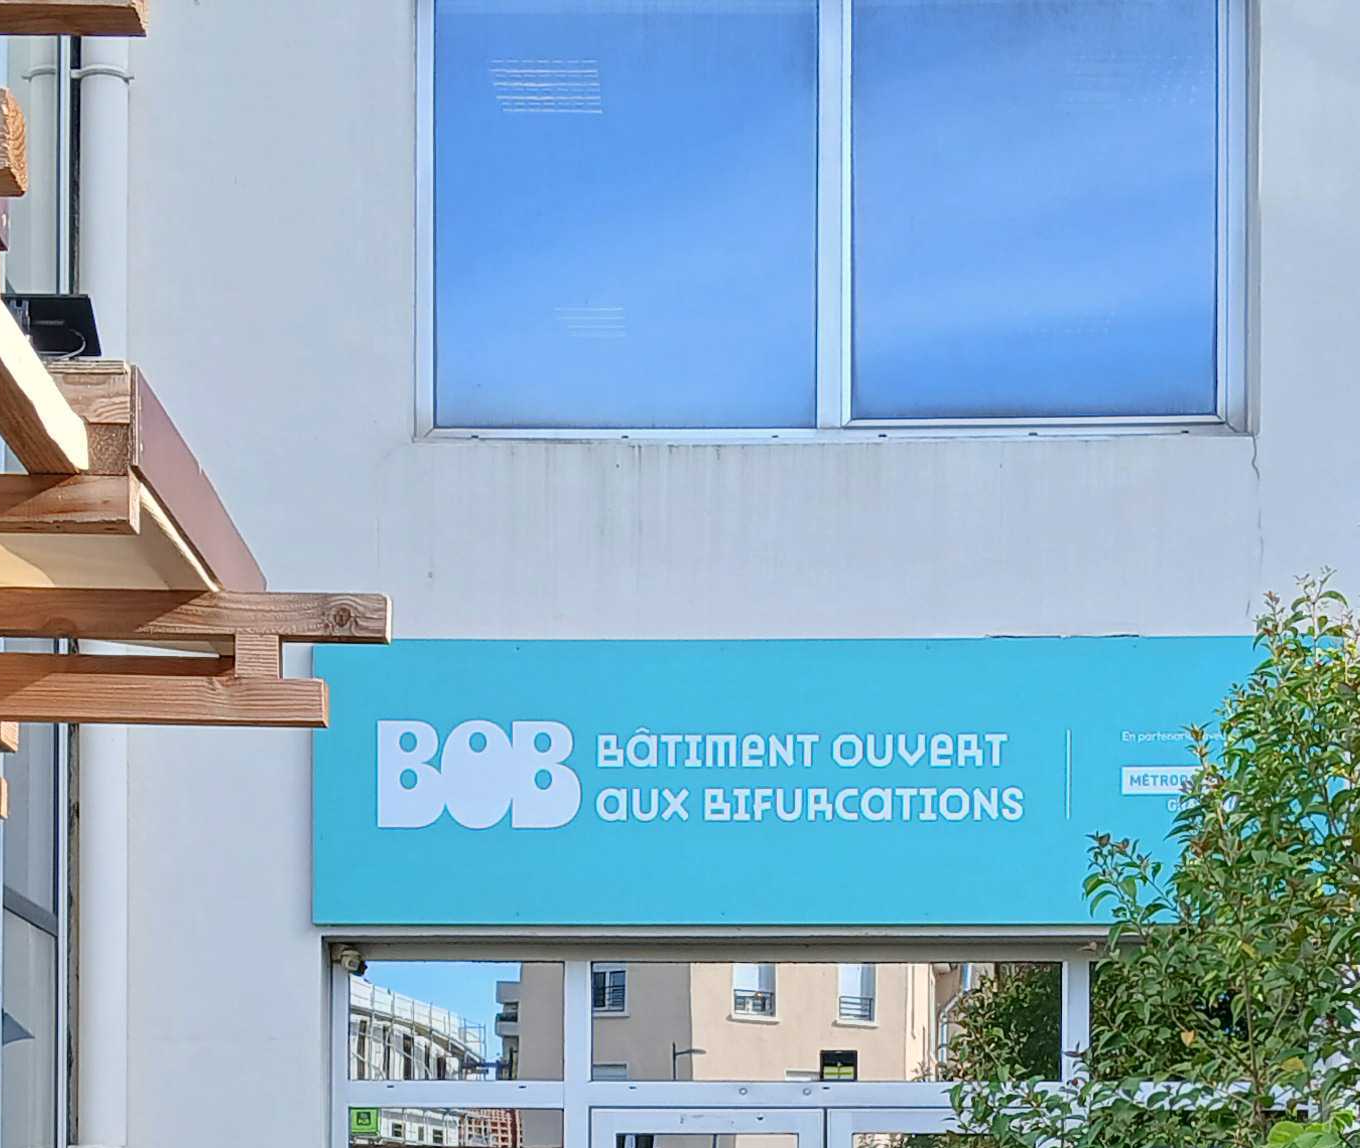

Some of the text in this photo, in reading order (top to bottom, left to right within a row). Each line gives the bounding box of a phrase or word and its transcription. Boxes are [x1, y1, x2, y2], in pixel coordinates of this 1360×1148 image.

[598, 726, 1009, 767] BÂTIMENT OUVERT
[1122, 731, 1136, 741] En
[377, 720, 582, 829] BOB
[704, 787, 1024, 822] BIFURCATIONS
